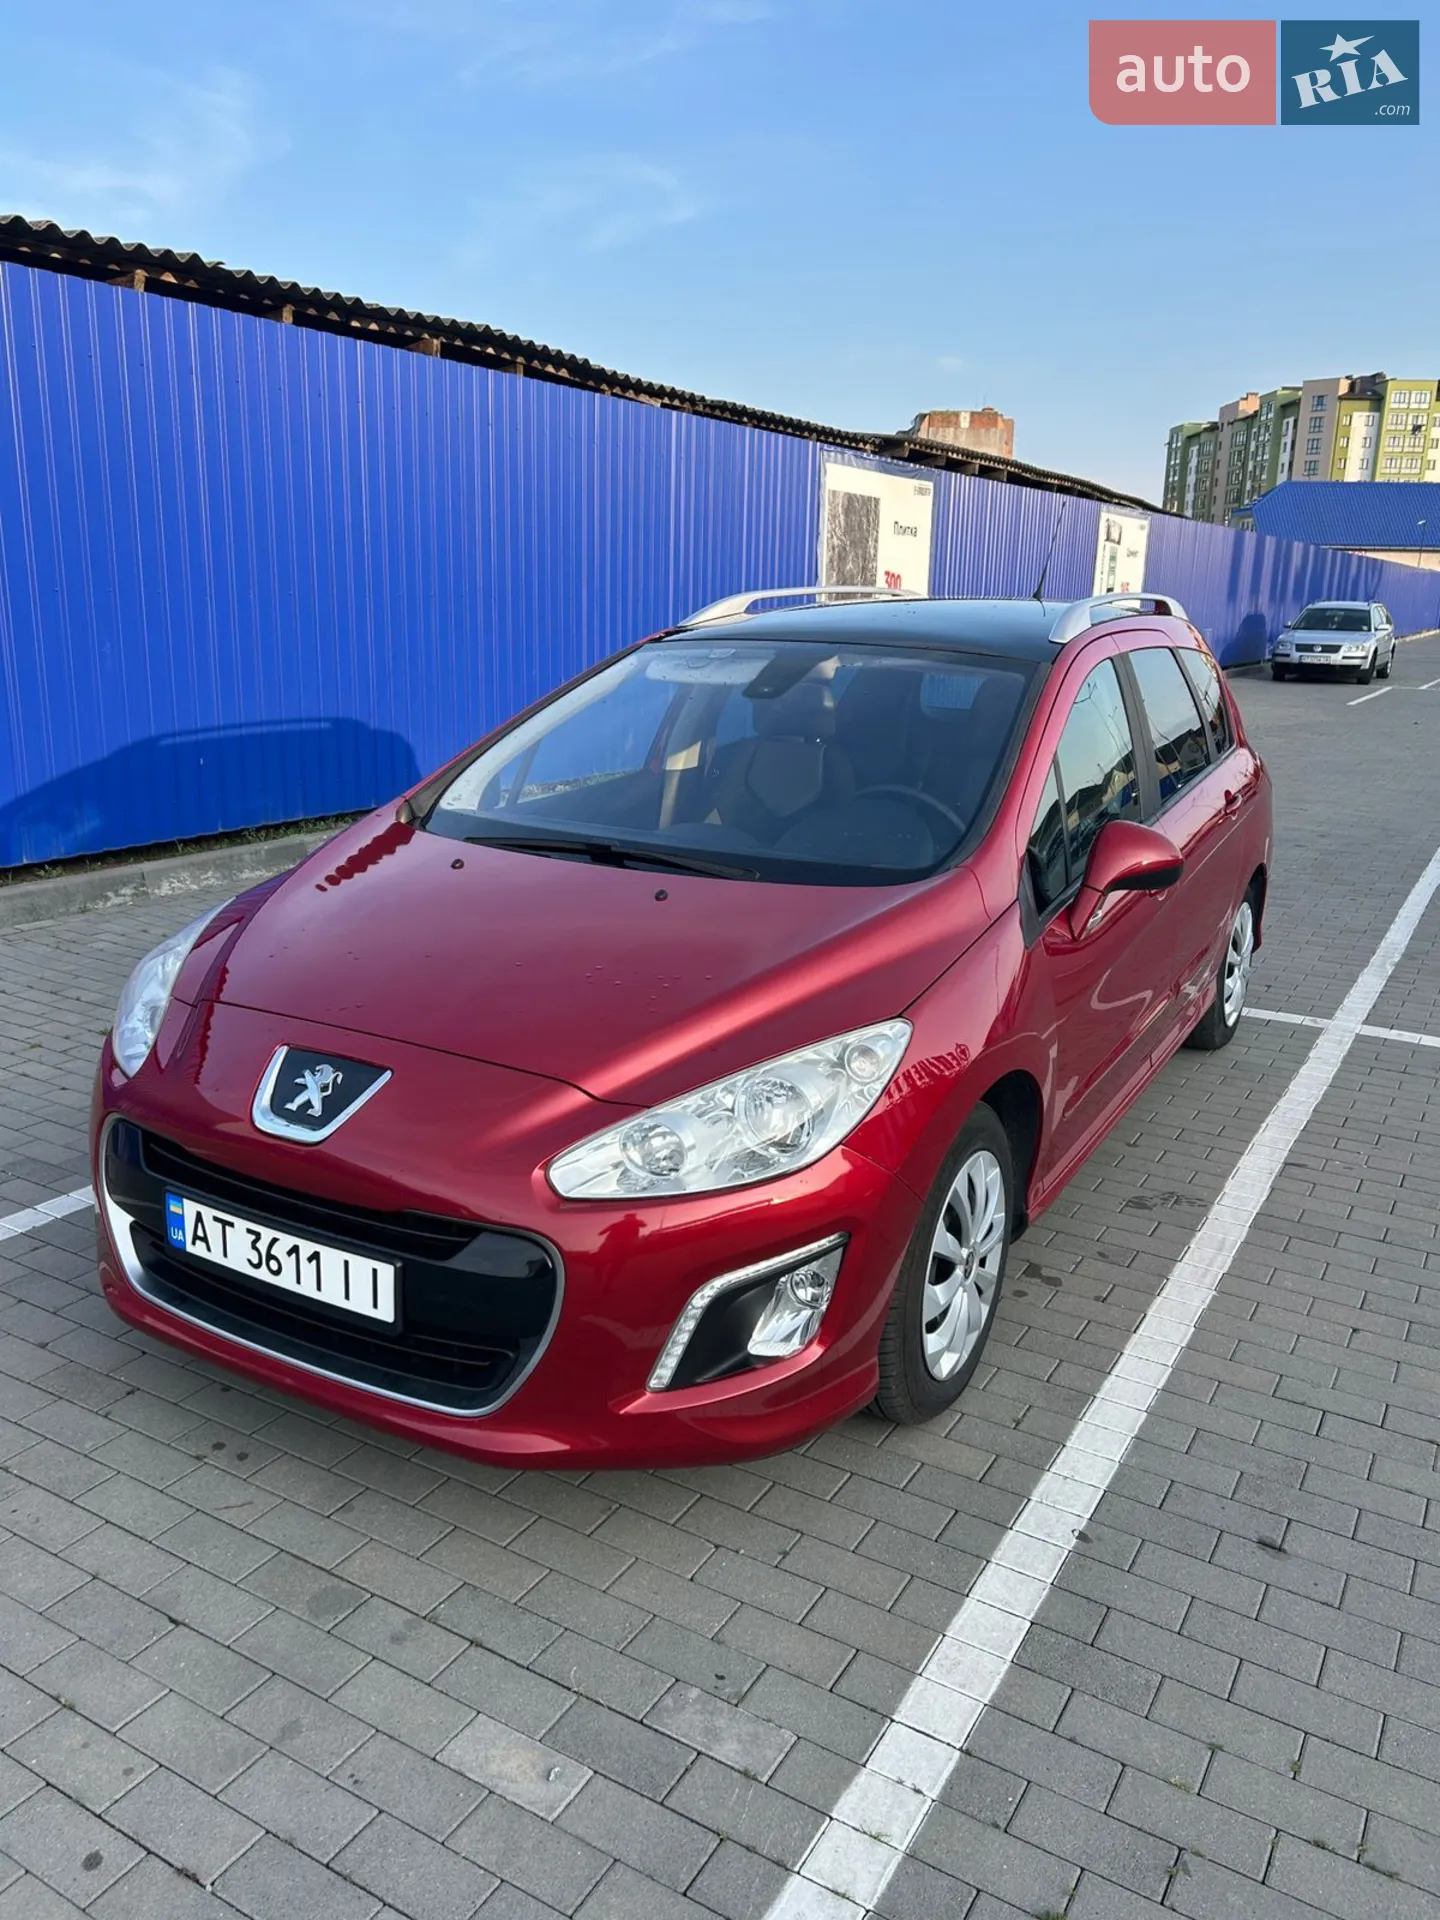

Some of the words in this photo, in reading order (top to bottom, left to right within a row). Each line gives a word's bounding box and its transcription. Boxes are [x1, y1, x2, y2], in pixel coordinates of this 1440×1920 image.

[171, 1226, 184, 1241] UA
[191, 1210, 235, 1259] AT
[245, 1228, 322, 1293] 3611
